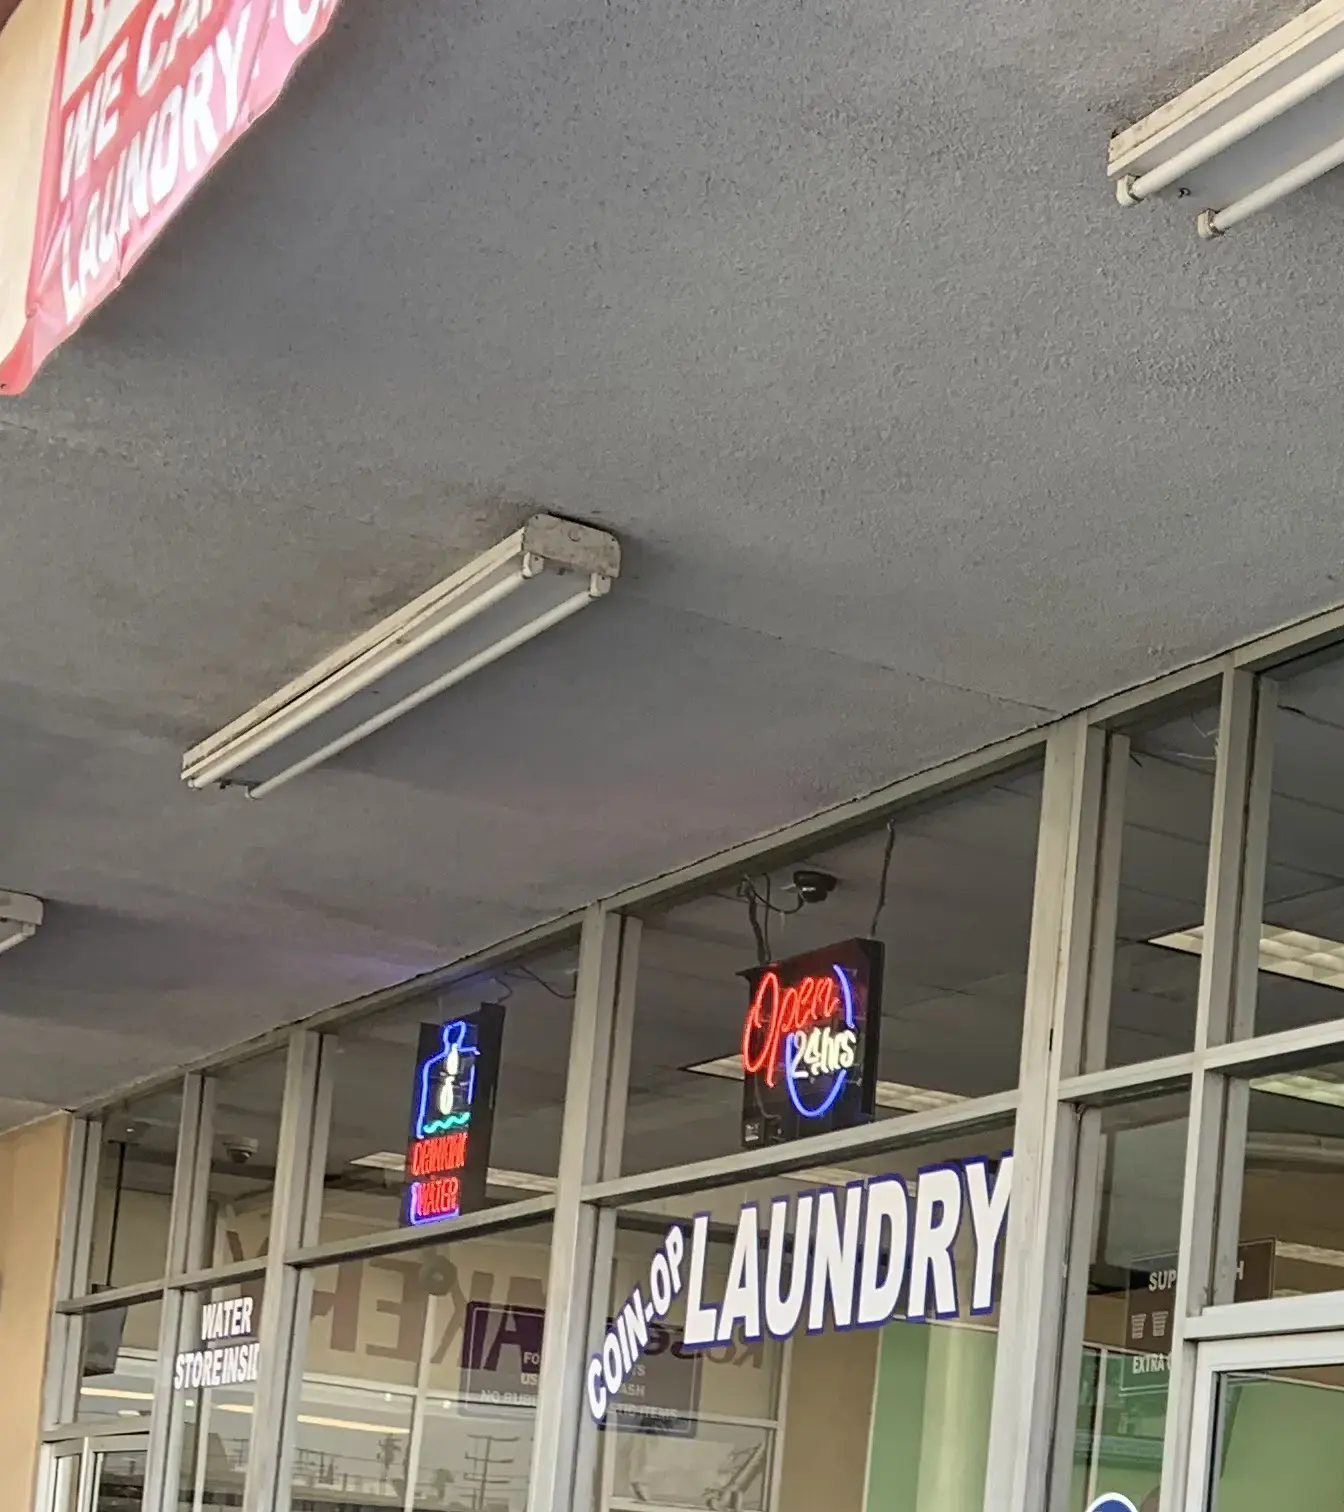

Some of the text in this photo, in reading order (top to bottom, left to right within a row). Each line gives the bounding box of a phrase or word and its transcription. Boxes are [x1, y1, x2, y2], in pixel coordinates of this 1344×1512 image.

[60, 0, 250, 325] LAUNDRY
[742, 972, 841, 1090] Open
[418, 1177, 459, 1216] WATER
[684, 1150, 1016, 1349] LAUNDRY
[1149, 1268, 1177, 1292] SUP
[201, 1296, 253, 1341] WATER
[585, 1224, 687, 1423] COIN-OP
[174, 1347, 222, 1390] STORE
[1133, 1353, 1165, 1375] EXTRA
